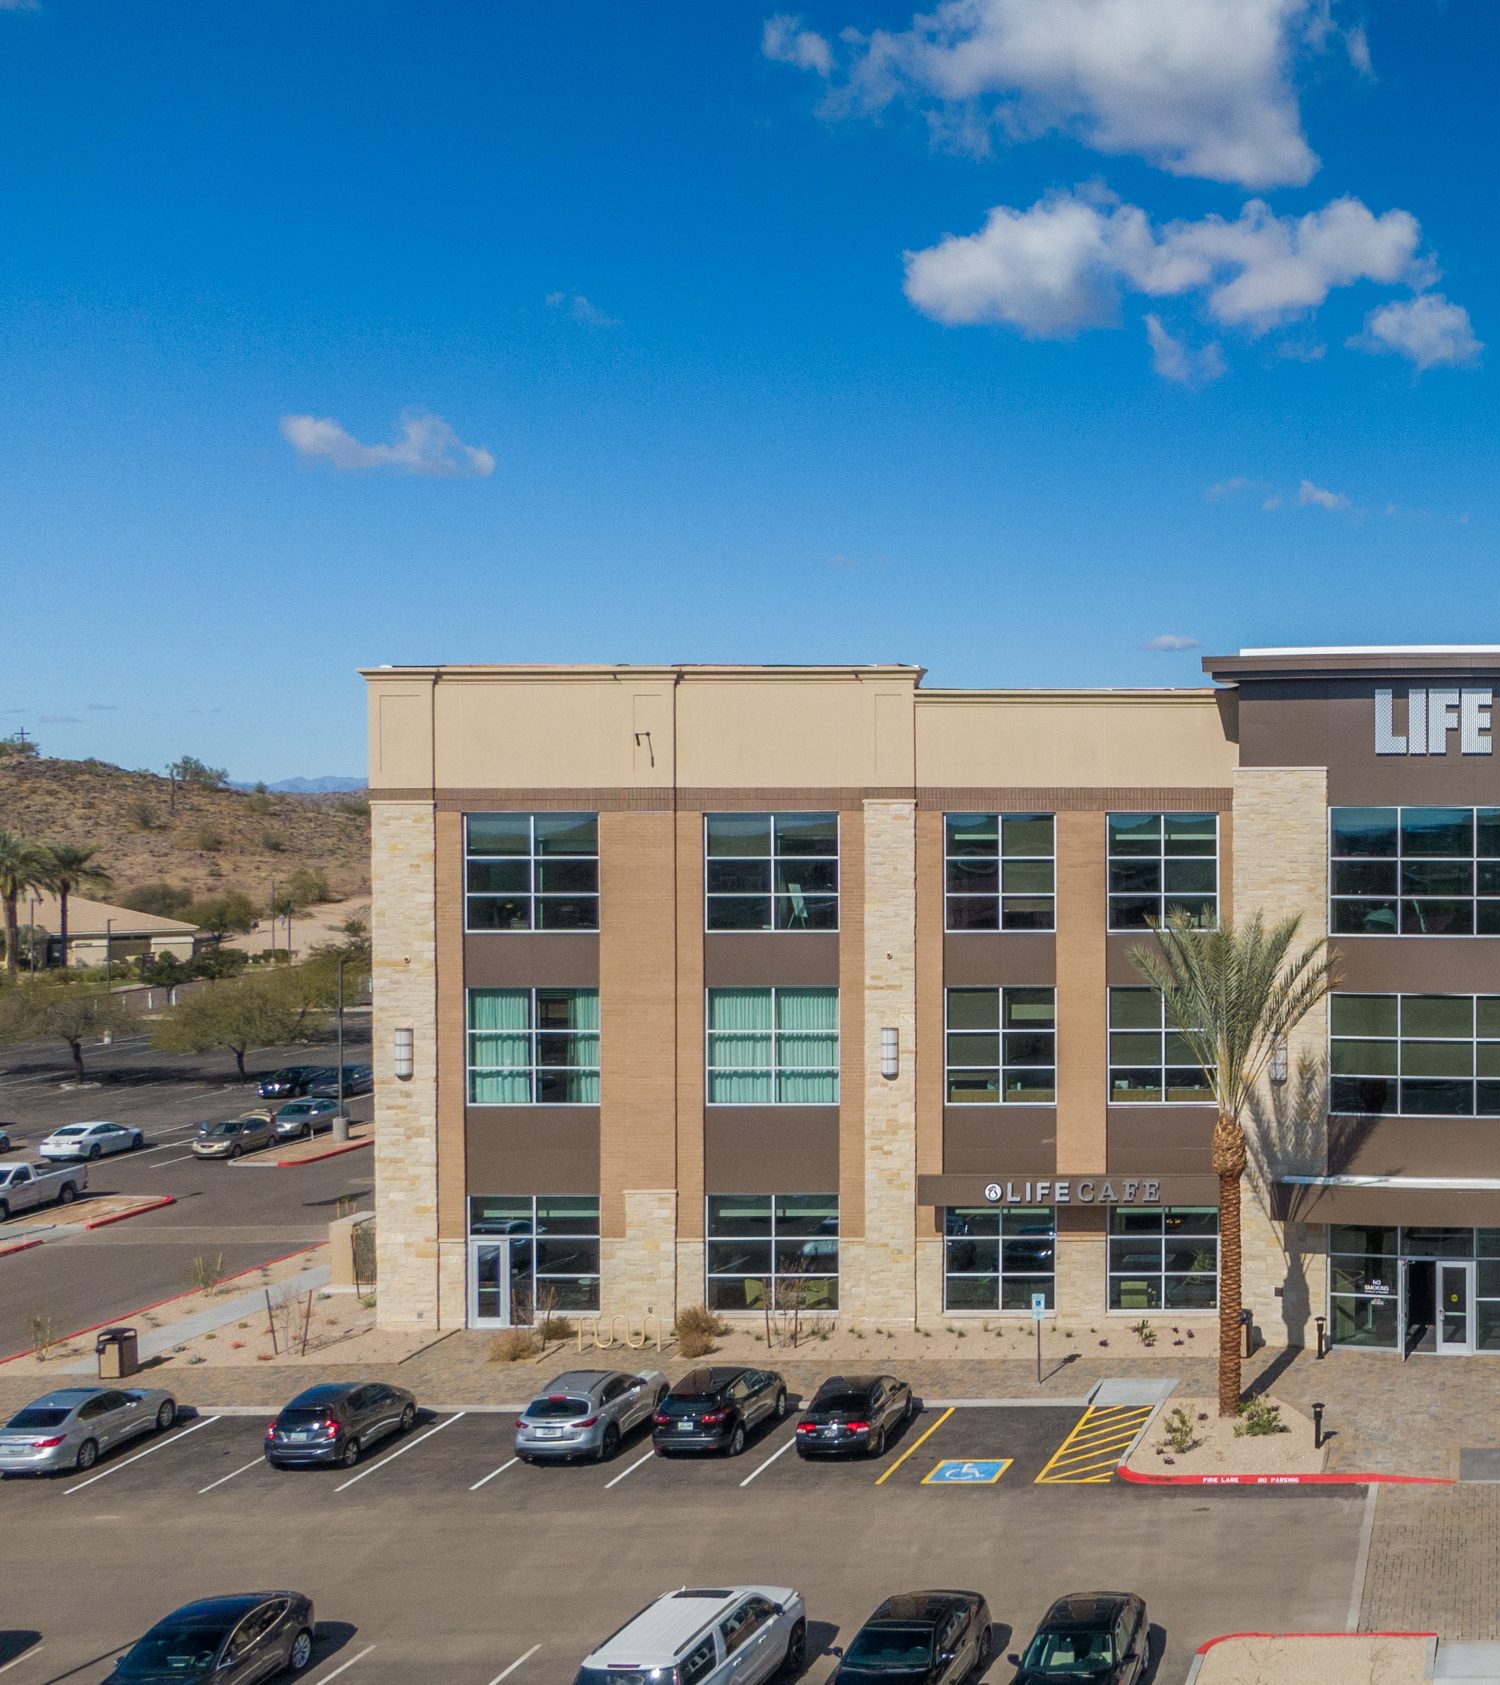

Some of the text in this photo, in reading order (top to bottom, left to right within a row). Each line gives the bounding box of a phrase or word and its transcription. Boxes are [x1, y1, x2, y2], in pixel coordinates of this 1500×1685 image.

[1375, 688, 1493, 754] LIFE
[1006, 1181, 1161, 1202] LIFE CAFE
